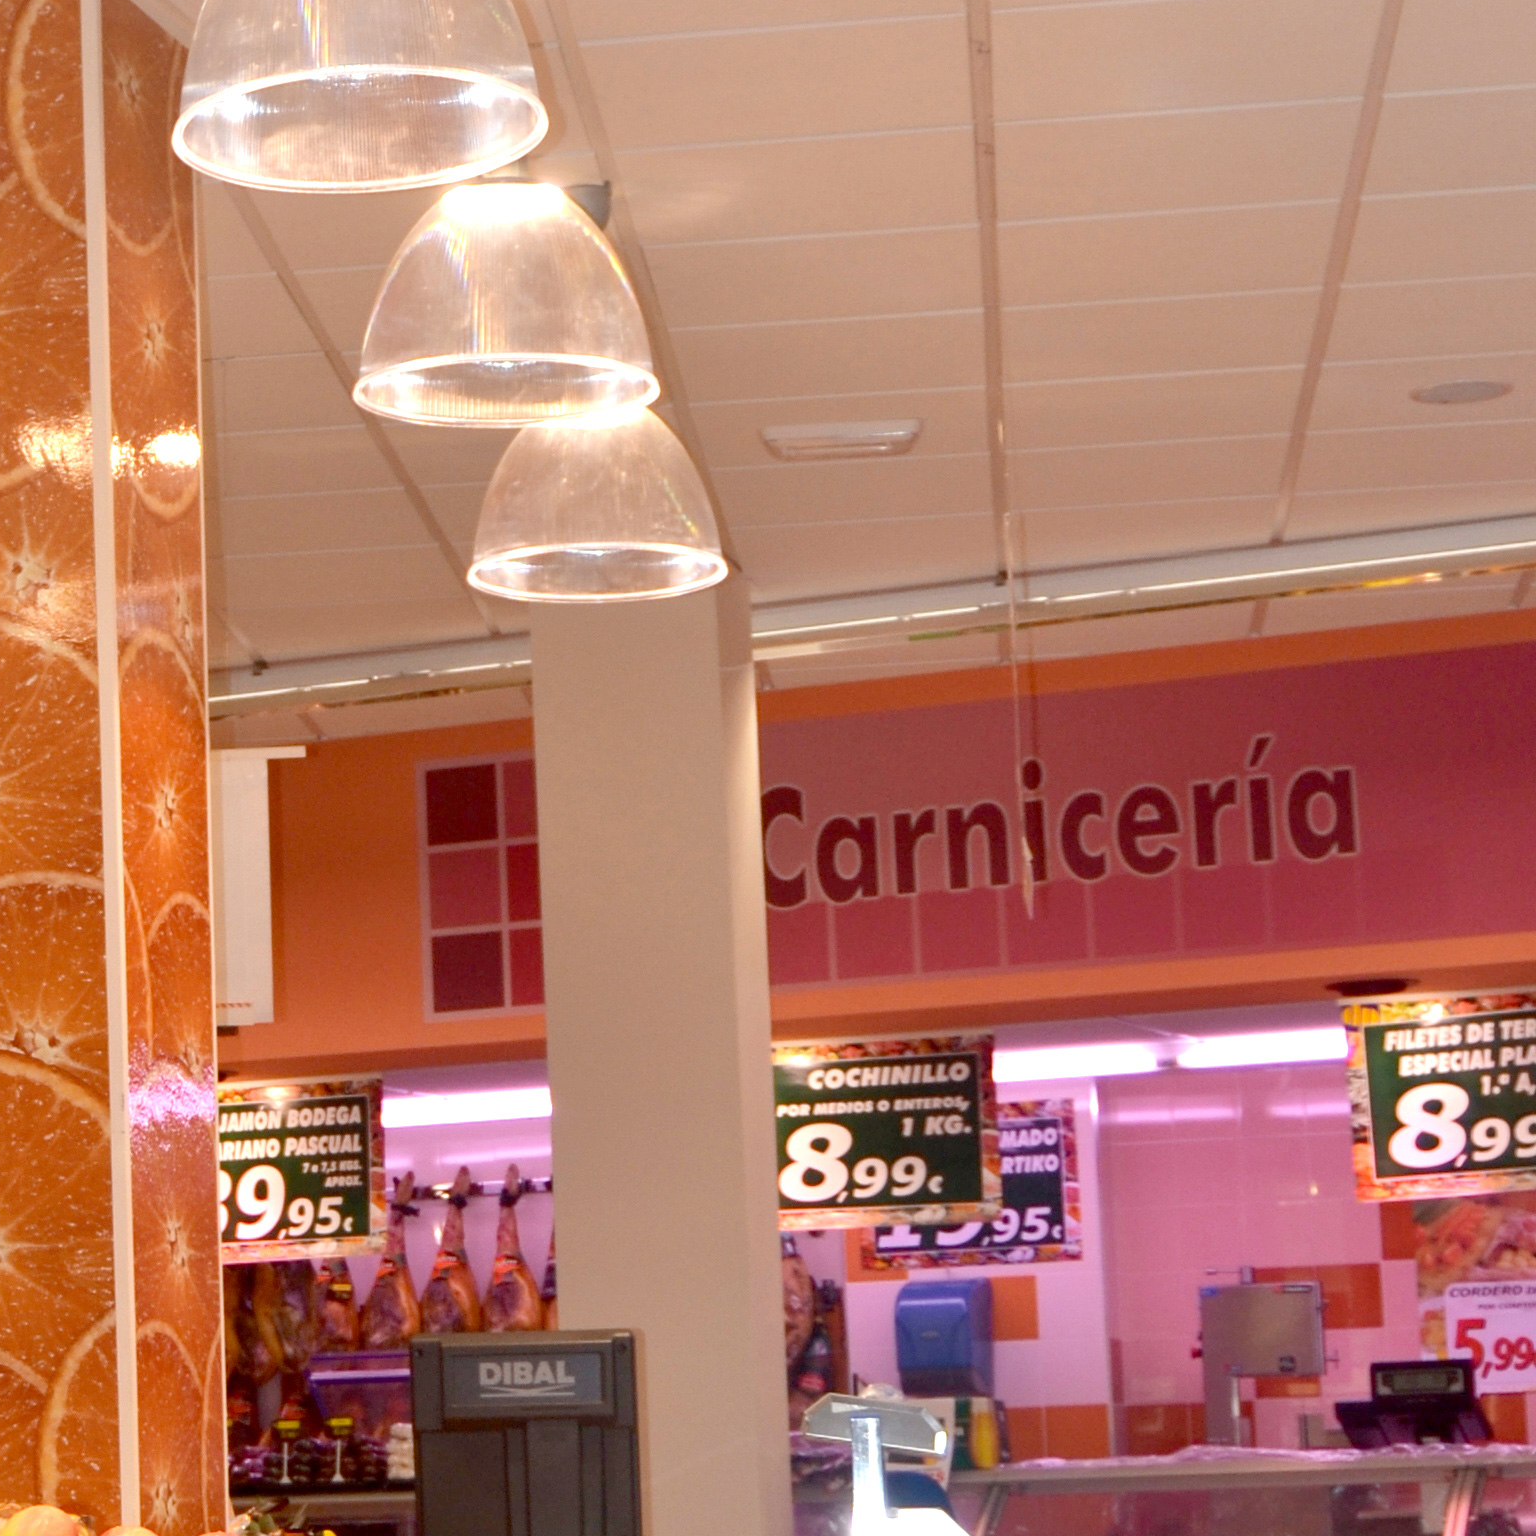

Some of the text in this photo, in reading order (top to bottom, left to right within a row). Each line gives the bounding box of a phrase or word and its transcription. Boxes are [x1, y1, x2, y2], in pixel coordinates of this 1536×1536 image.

[759, 735, 1358, 909] Carnicería
[1384, 1025, 1461, 1052] FILETES
[1466, 1022, 1495, 1043] DE
[808, 1062, 970, 1090] COCHINILLO
[1398, 1048, 1495, 1077] ESPECIAL
[219, 1104, 361, 1132] JAMÓN BODEGA
[776, 1103, 810, 1118] POR
[814, 1100, 874, 1116] MEDIOS
[901, 1115, 972, 1137] 1 KG.
[284, 1134, 362, 1157] PASCUAL
[778, 1122, 944, 1203] 8,99€
[324, 1175, 363, 1188] APROX.
[1450, 1285, 1522, 1298] CORDERO
[1455, 1317, 1536, 1379] 5,99
[479, 1361, 576, 1386] DIBAL
